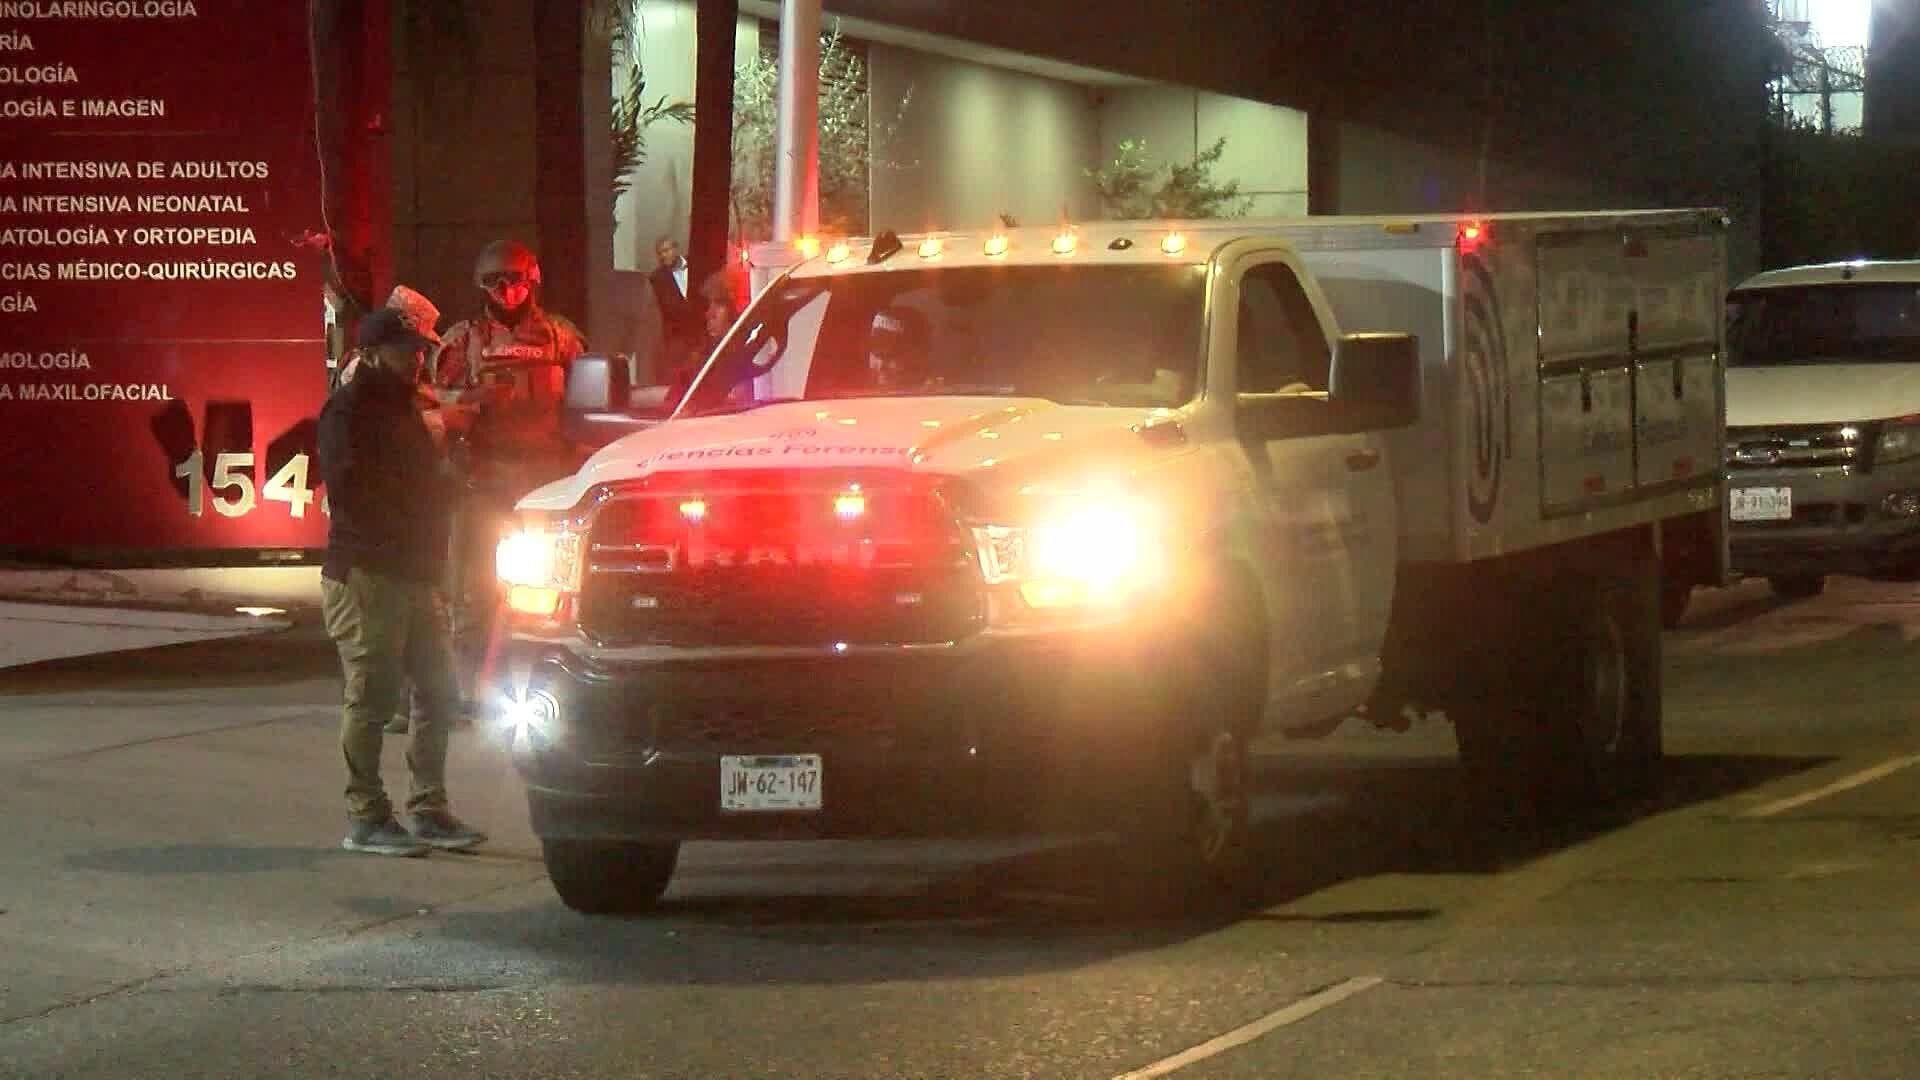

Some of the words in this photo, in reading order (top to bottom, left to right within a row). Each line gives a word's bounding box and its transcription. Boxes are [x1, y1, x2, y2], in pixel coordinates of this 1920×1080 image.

[63, 100, 75, 116] E
[82, 100, 164, 116] IMAGEN
[23, 162, 131, 178] INTENSIVA
[137, 162, 165, 178] DE
[170, 161, 268, 178] ADULTOS
[23, 196, 132, 212] INTENSIVA
[138, 196, 249, 212] NEONATAL
[114, 230, 128, 244] Y
[134, 228, 256, 245] ORTOPEDIA
[2, 263, 50, 280] CIAS
[58, 258, 296, 279] MÉDICO-QUIRÚRGICAS
[0, 292, 37, 312] GÍA
[20, 384, 174, 400] MAXILOFACIAL
[175, 452, 330, 520] 154
